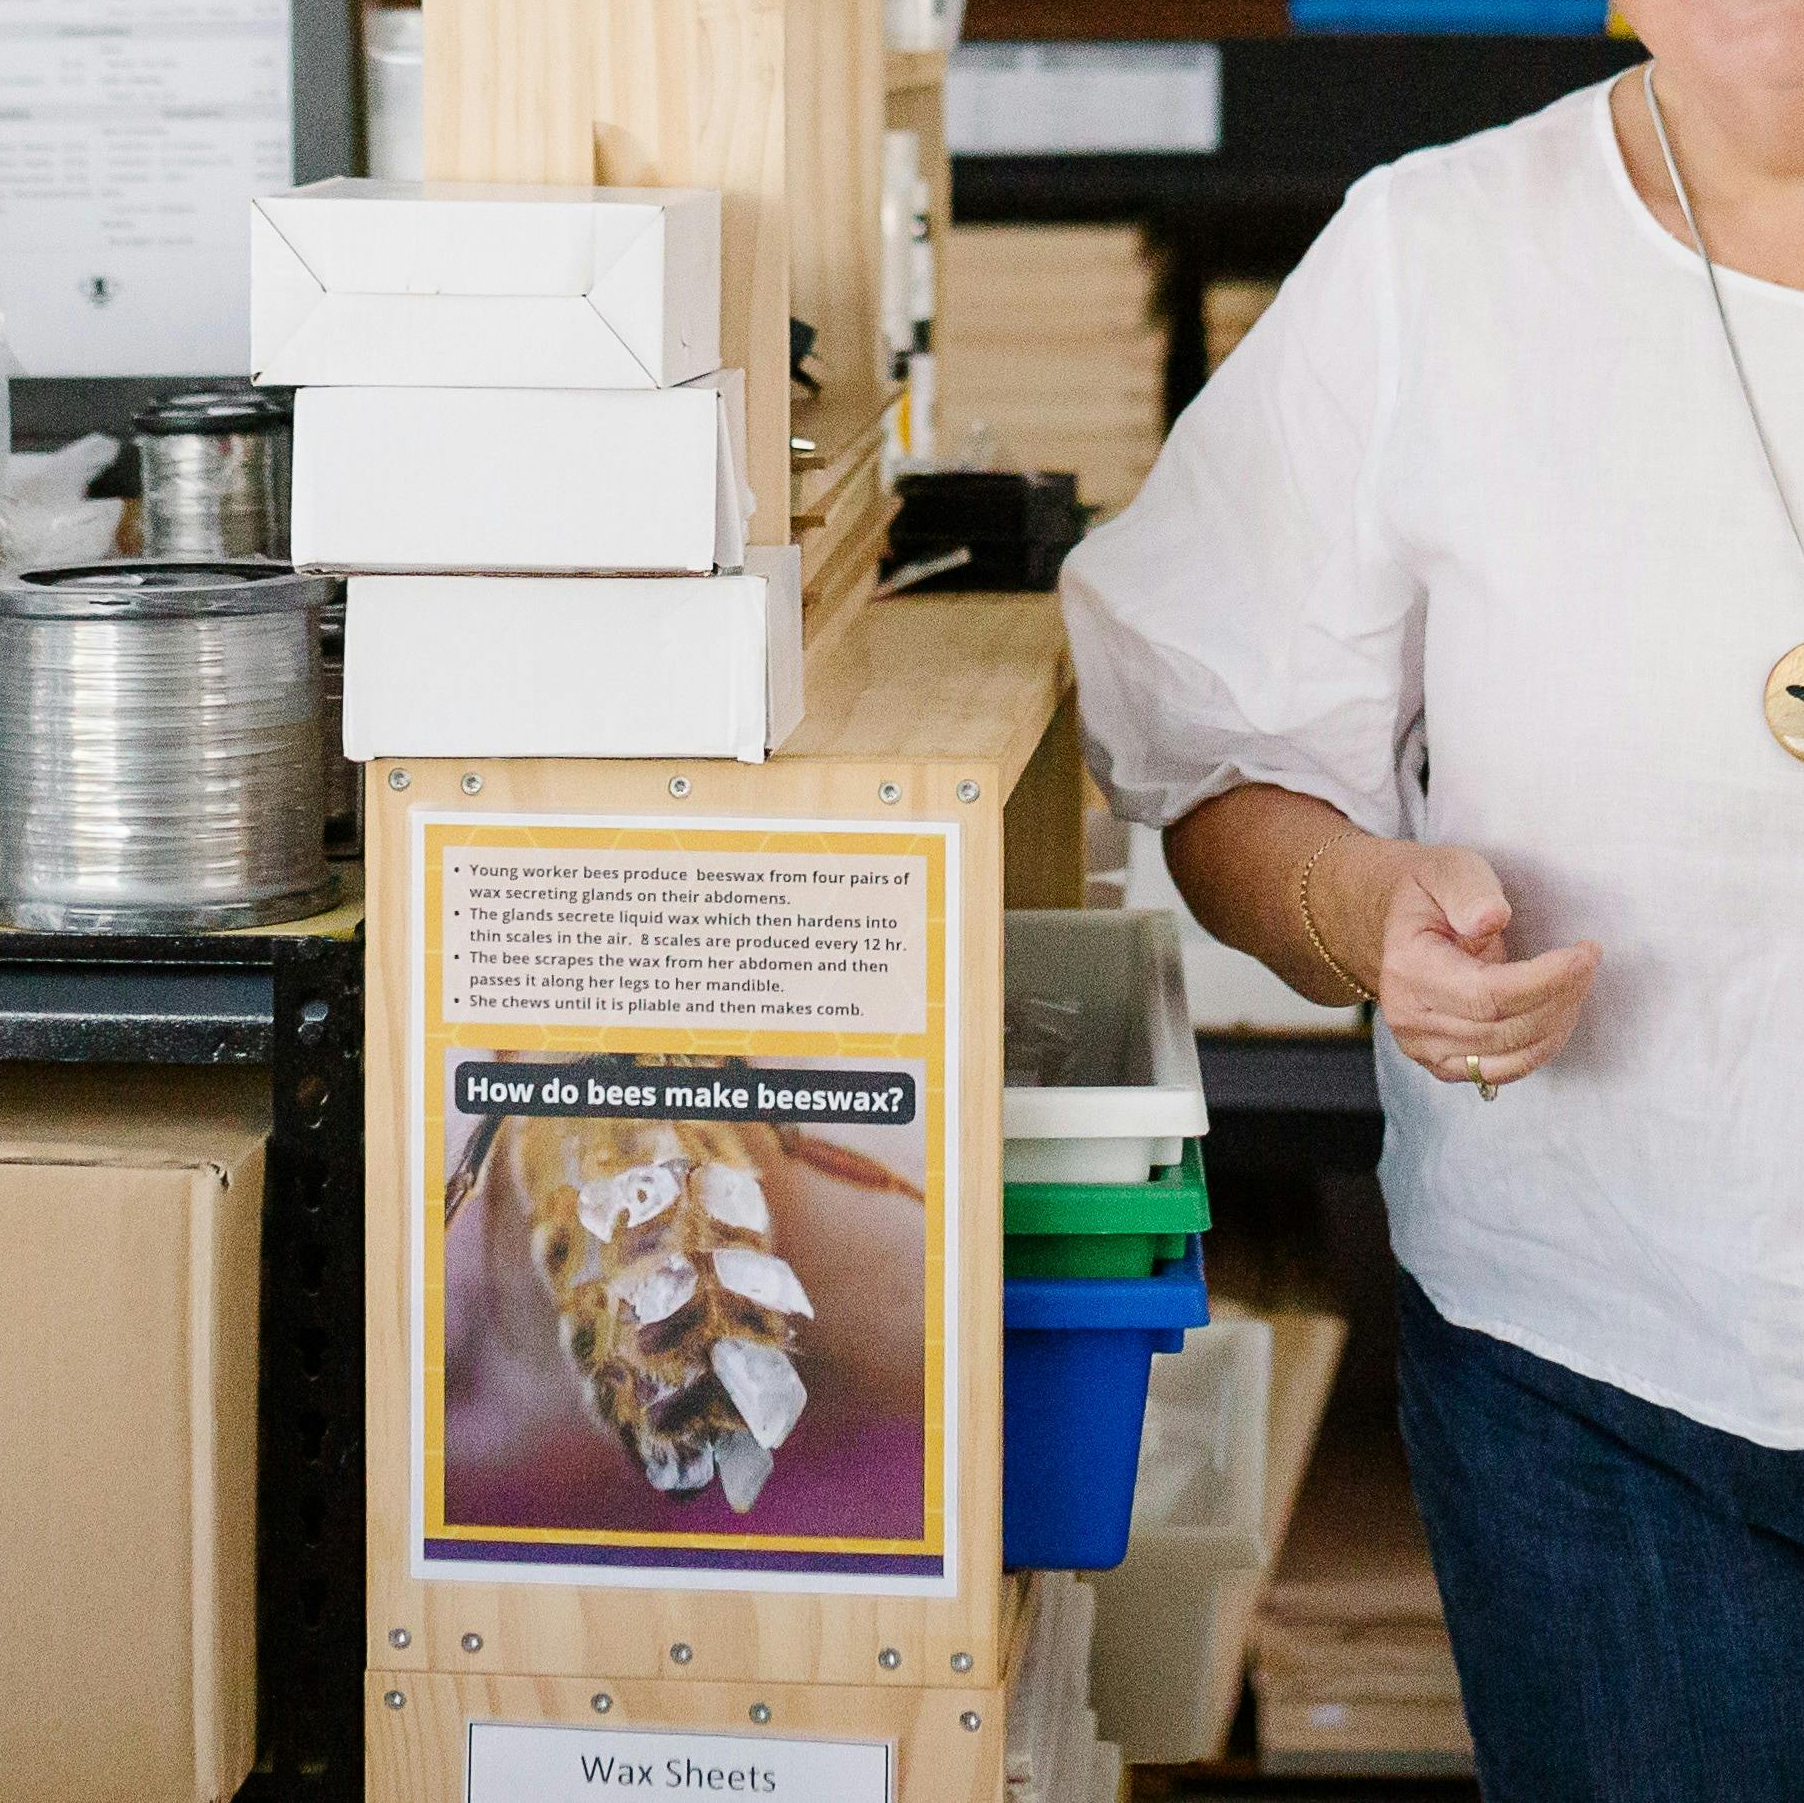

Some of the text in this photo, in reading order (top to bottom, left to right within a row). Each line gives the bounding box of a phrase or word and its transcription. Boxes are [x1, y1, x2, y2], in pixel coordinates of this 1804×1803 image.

[469, 863, 911, 889] Young worker bees produce beeswax from four pairs of
[469, 886, 791, 906] wax secreting glands on their abdomens.
[469, 906, 898, 930] The glands secrete liquid wax which then hardens into
[469, 928, 907, 955] thin scales in the air. 8 scales are produced every 12 hr.
[469, 950, 889, 974] The bee scrapes the wax from her abdomen and then
[469, 973, 785, 994] passes it along her legs to her mandible.
[469, 994, 864, 1017] She chews until it is pliable and then makes comb.
[465, 1076, 904, 1113] How do bees make beeswax?
[580, 1754, 776, 1791] Wax Sheets
